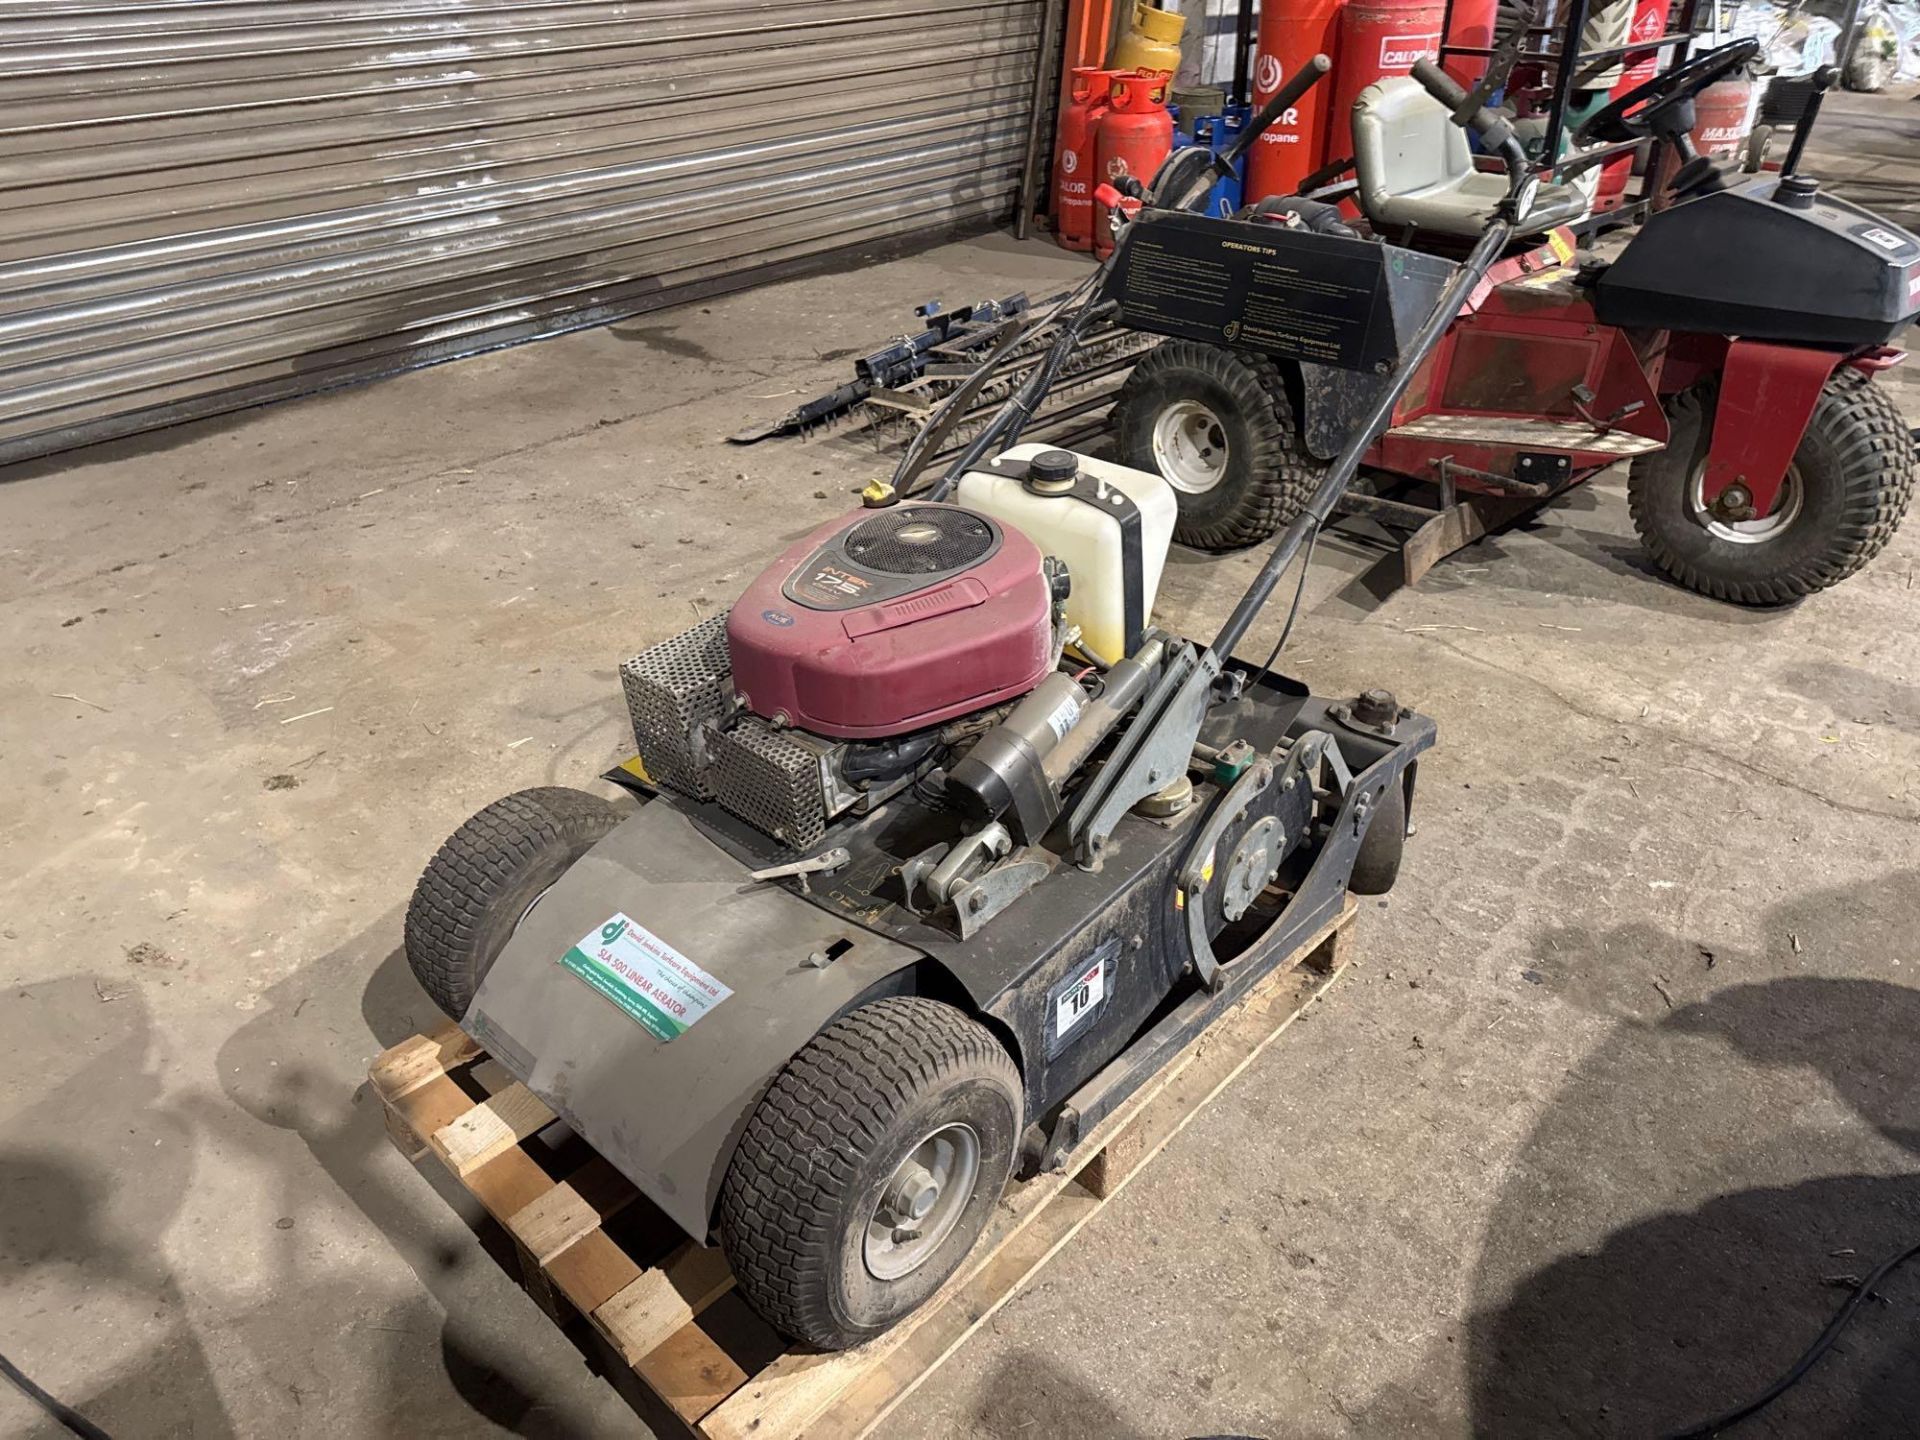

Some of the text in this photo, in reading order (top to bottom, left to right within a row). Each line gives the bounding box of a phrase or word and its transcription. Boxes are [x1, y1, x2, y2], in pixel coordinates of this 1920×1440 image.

[1260, 133, 1300, 144] ropane
[1222, 240, 1277, 256] OPERATORS TIPS
[1300, 336, 1330, 346] Equipment
[822, 566, 873, 588] INTEK
[627, 929, 720, 996] David Jenkins Turfcare Equipment Ltd
[598, 948, 687, 1017] SLA 500 LINEAR AERATOR
[664, 976, 678, 987] choice
[682, 990, 708, 1009] champions
[1070, 984, 1090, 1016] 10
